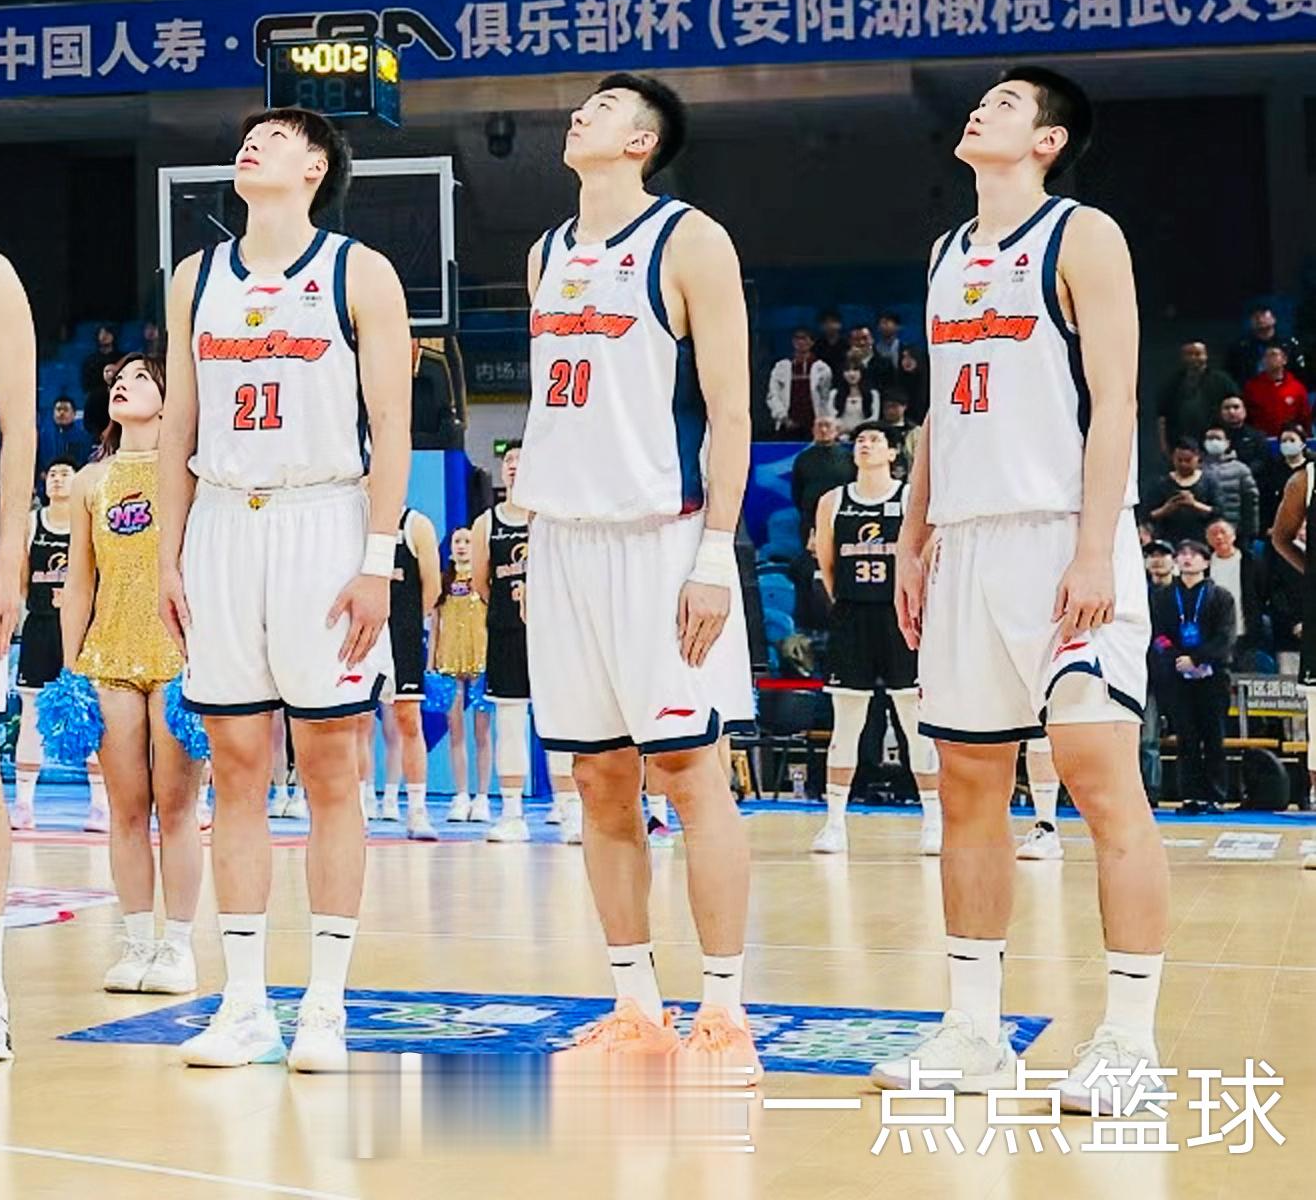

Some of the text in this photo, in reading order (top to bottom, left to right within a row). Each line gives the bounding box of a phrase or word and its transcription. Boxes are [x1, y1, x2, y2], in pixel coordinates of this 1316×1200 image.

[233, 382, 282, 431] 21
[546, 359, 591, 408] 28
[951, 362, 990, 415] 41
[855, 560, 887, 583] 33
